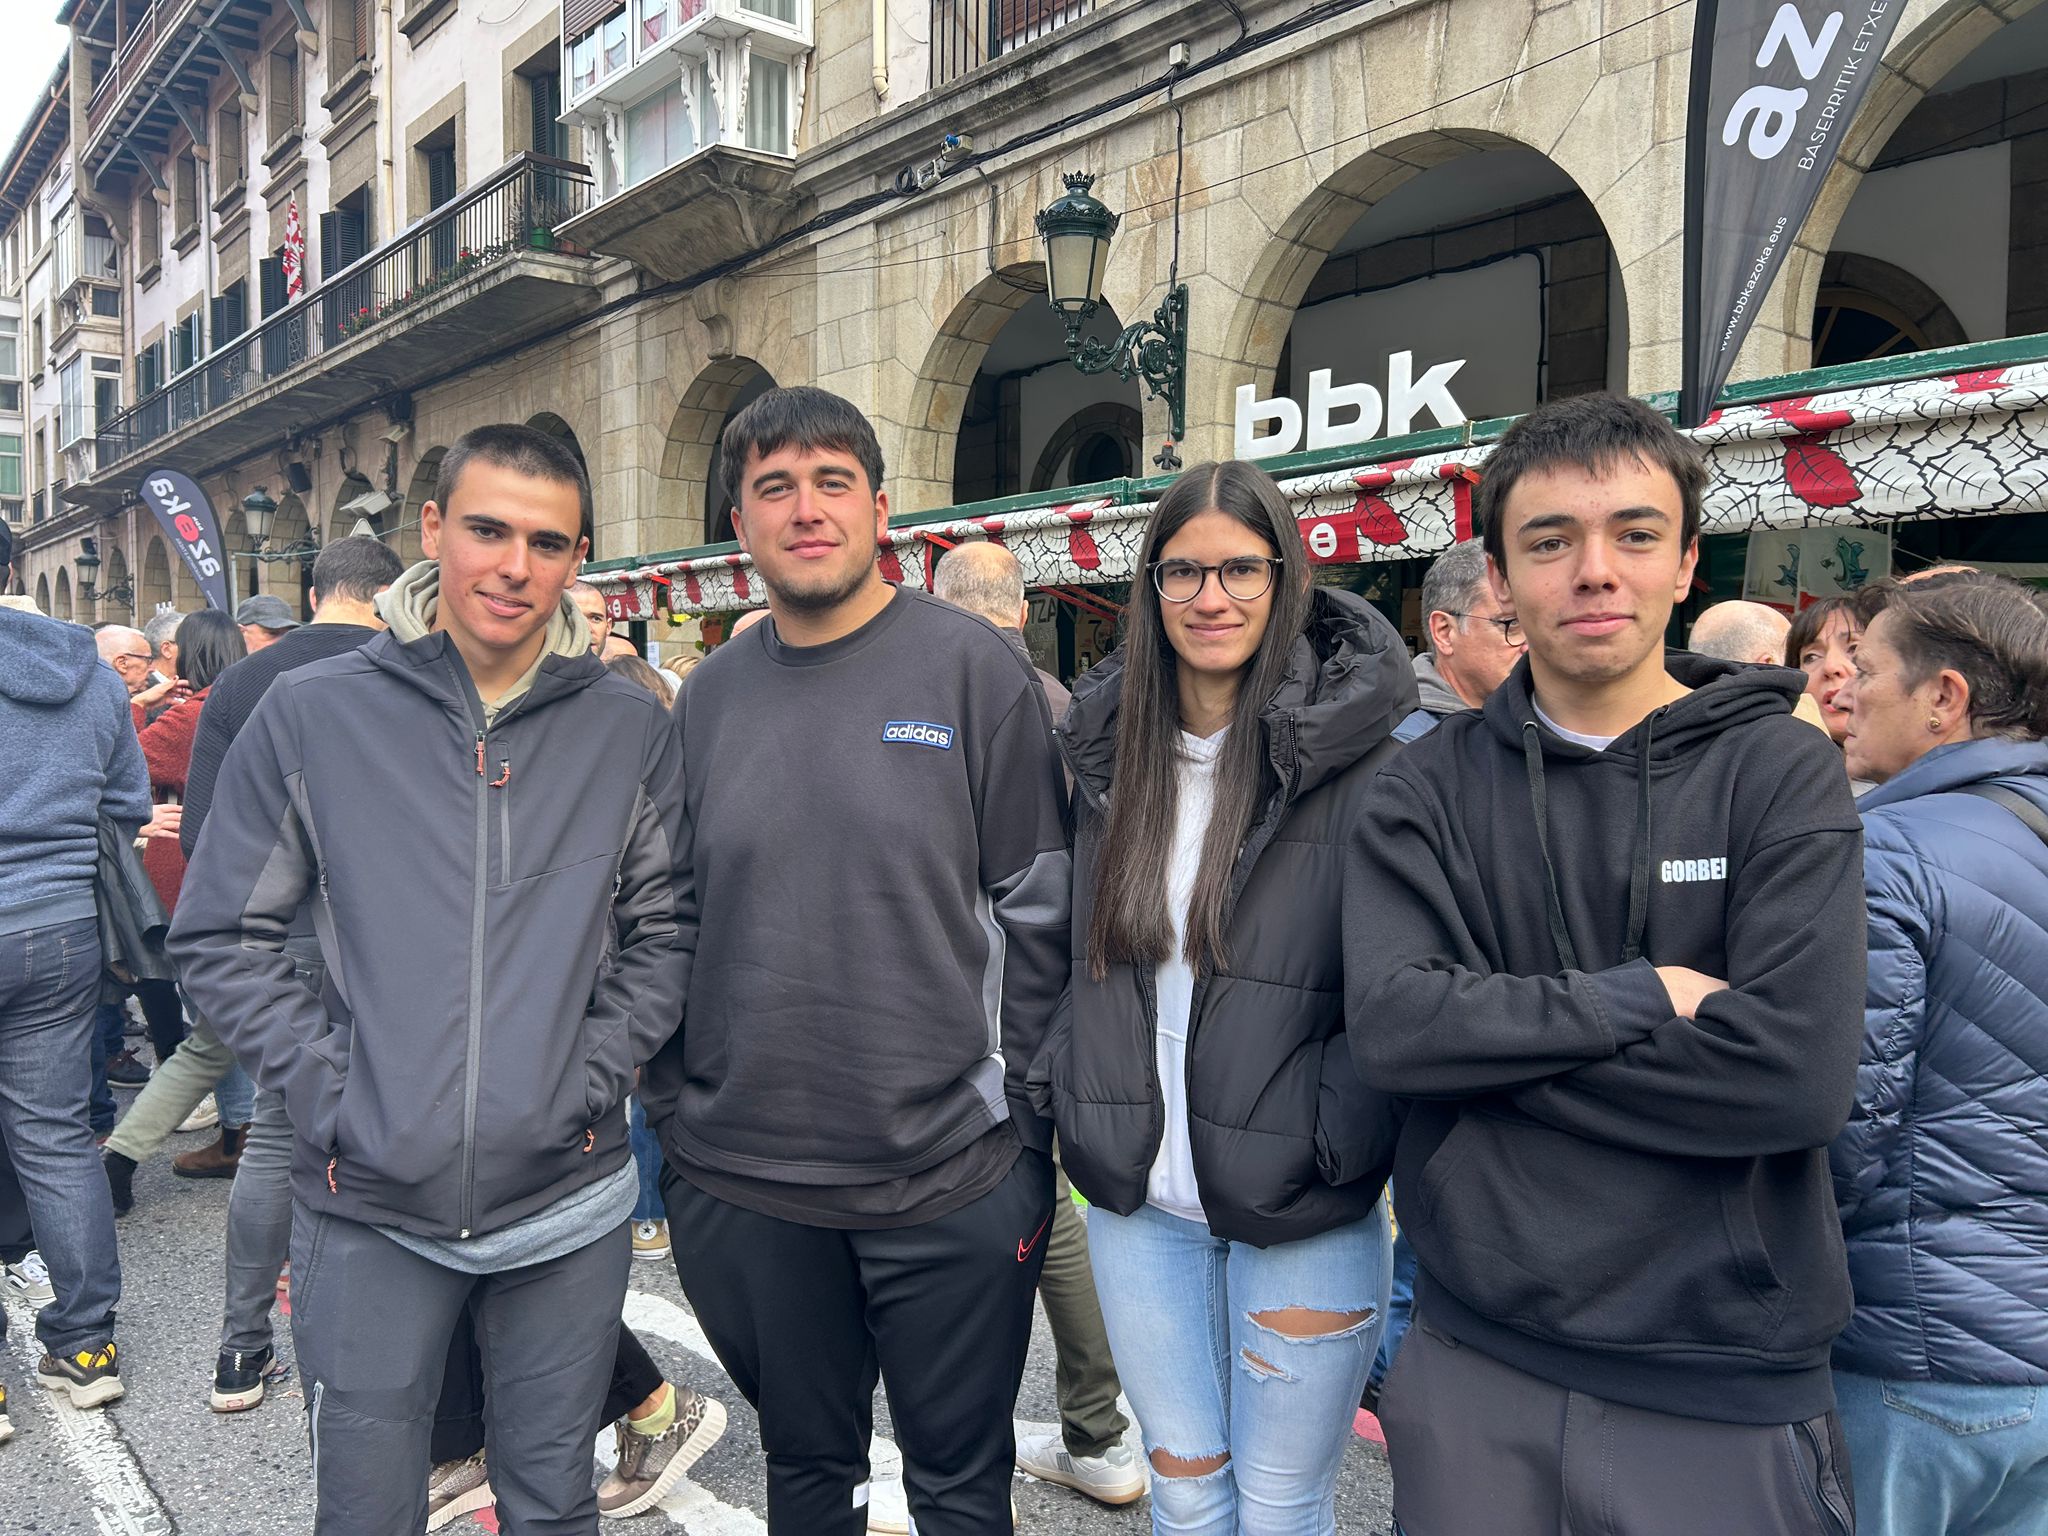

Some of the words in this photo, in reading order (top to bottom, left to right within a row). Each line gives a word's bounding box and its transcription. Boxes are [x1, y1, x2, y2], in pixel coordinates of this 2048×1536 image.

[1798, 57, 1862, 170] BASERRITIK
[1852, 1, 1888, 52] ETXE
[1720, 216, 1787, 352] www.bbkazoka.eus
[1234, 350, 1469, 461] bbk
[886, 724, 949, 745] adidas
